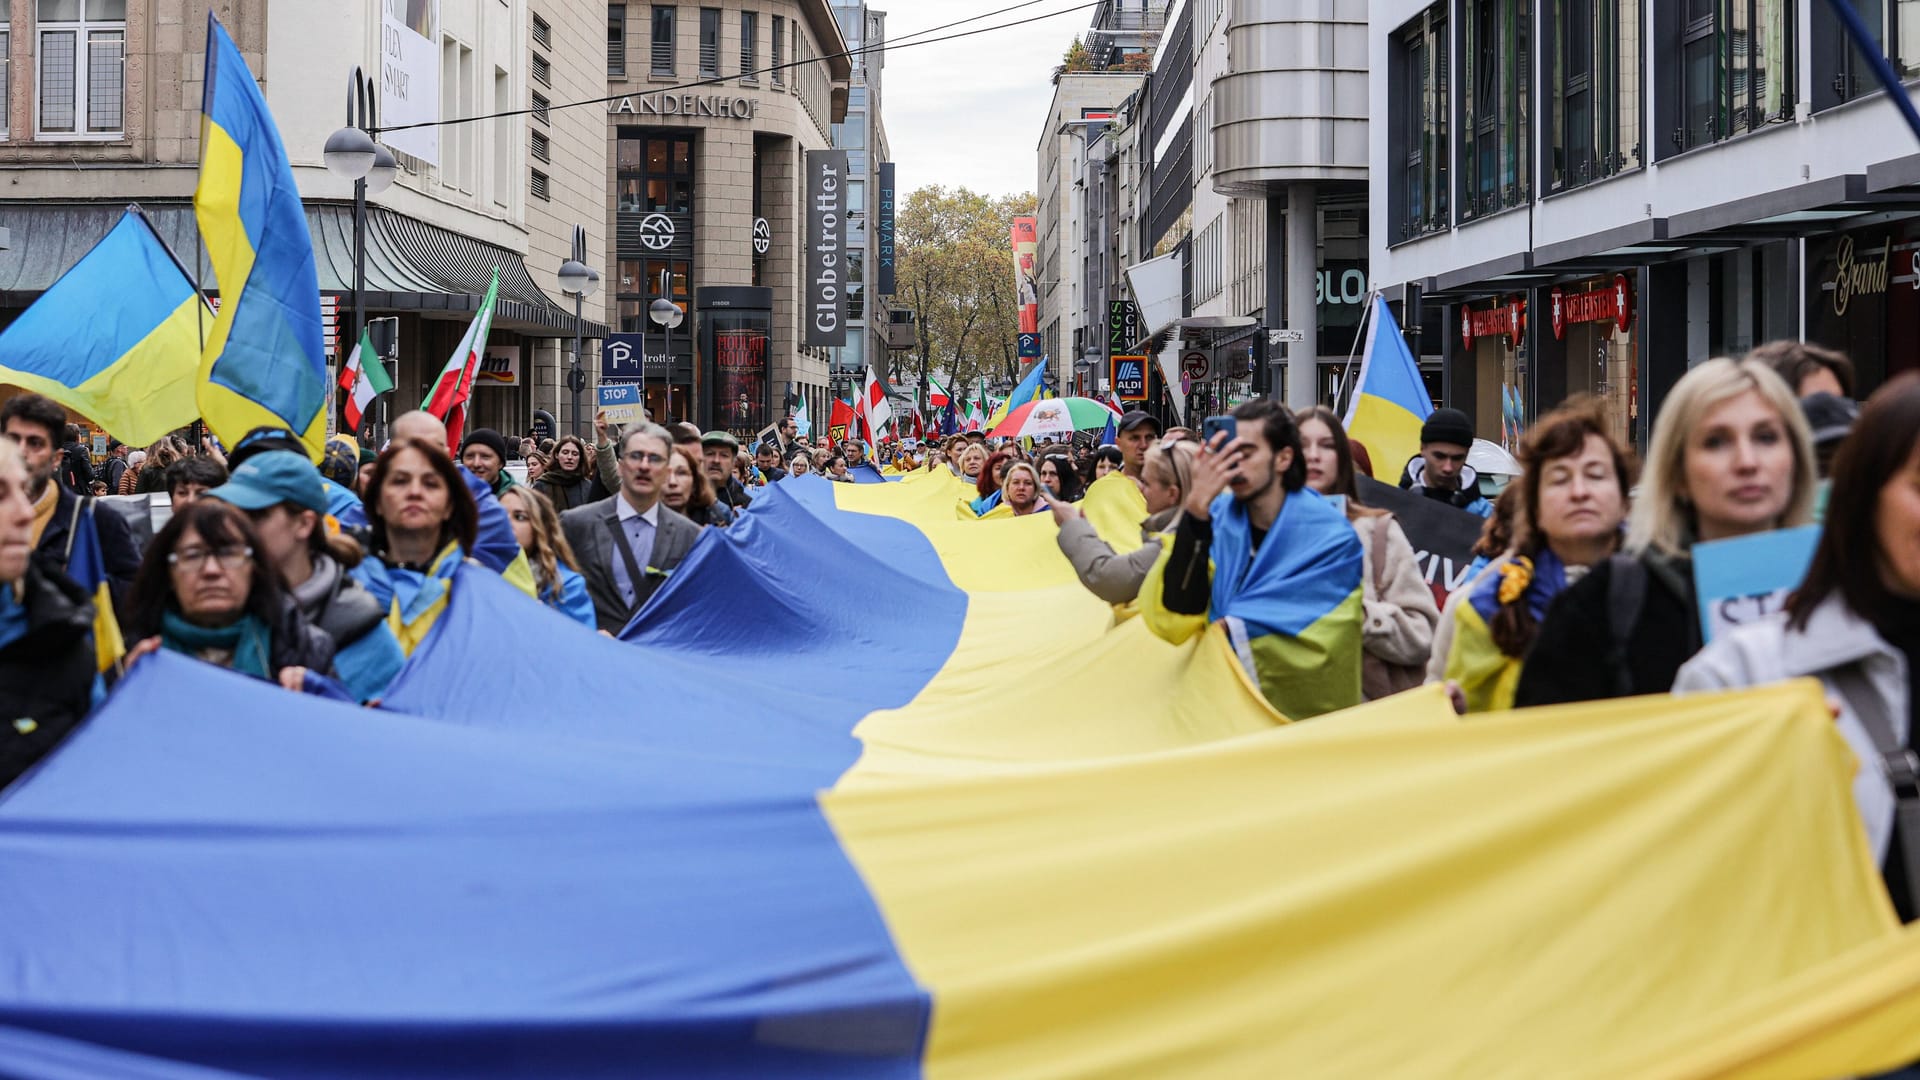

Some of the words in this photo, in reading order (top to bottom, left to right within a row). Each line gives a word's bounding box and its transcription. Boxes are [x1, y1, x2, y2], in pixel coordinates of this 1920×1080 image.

[385, 24, 403, 60] FLEX
[384, 62, 410, 101] SMART
[881, 189, 894, 267] PRIMARK
[816, 163, 838, 333] Globetrotter
[1834, 234, 1890, 315] Grand
[612, 347, 630, 369] P
[603, 388, 628, 400] STOP
[1118, 381, 1142, 389] ALDI
[606, 408, 633, 418] PUTIN
